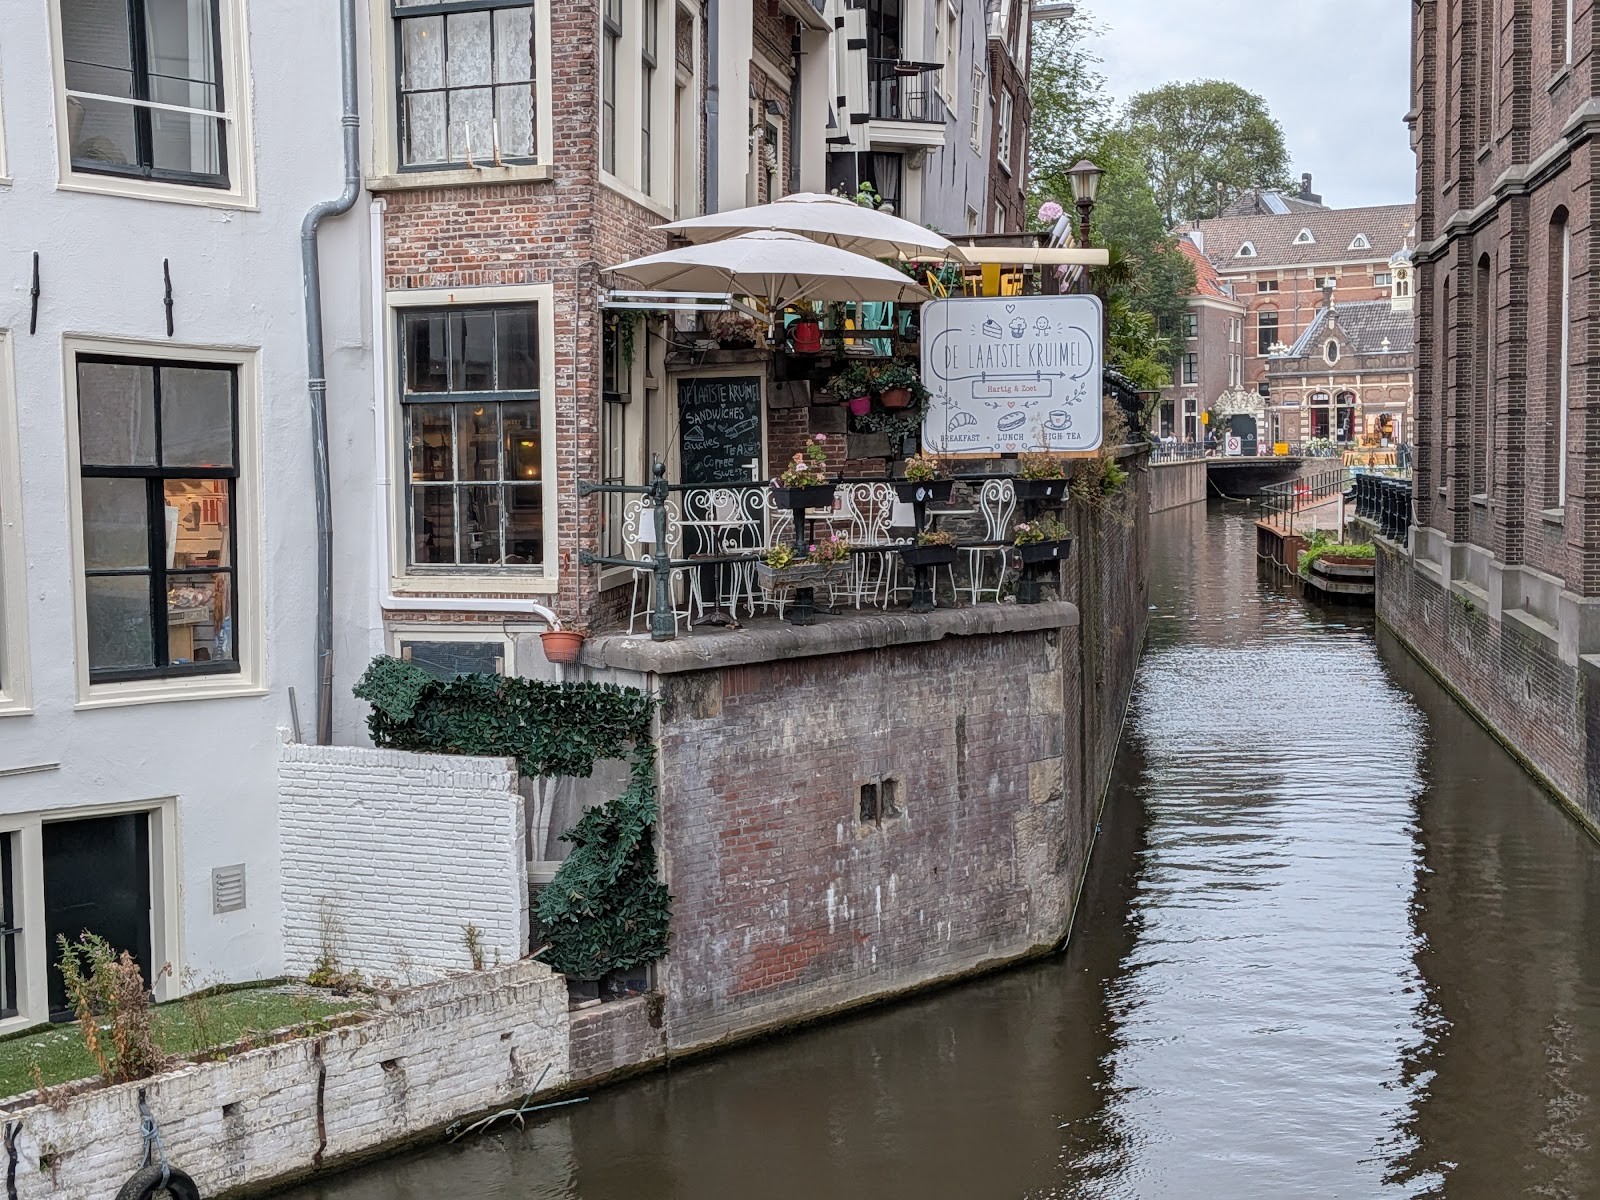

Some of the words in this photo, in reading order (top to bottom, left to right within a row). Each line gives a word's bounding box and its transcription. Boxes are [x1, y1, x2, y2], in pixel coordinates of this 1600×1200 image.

[944, 345, 959, 369] DE
[968, 343, 1021, 369] LAATSTE
[1028, 341, 1083, 367] KRUIMEL
[680, 386, 692, 404] DE
[693, 384, 727, 405] LAATSTE
[729, 382, 760, 402] KRUIMEL
[987, 385, 1012, 394] Hartig
[1021, 384, 1038, 392] Zoet
[685, 407, 744, 424] SANDWICHES
[940, 434, 981, 442] BREAKFAST
[997, 433, 1024, 441] LUNCH
[1043, 432, 1063, 440] HIGH
[1067, 432, 1082, 440] TEA
[723, 444, 744, 456] TEA
